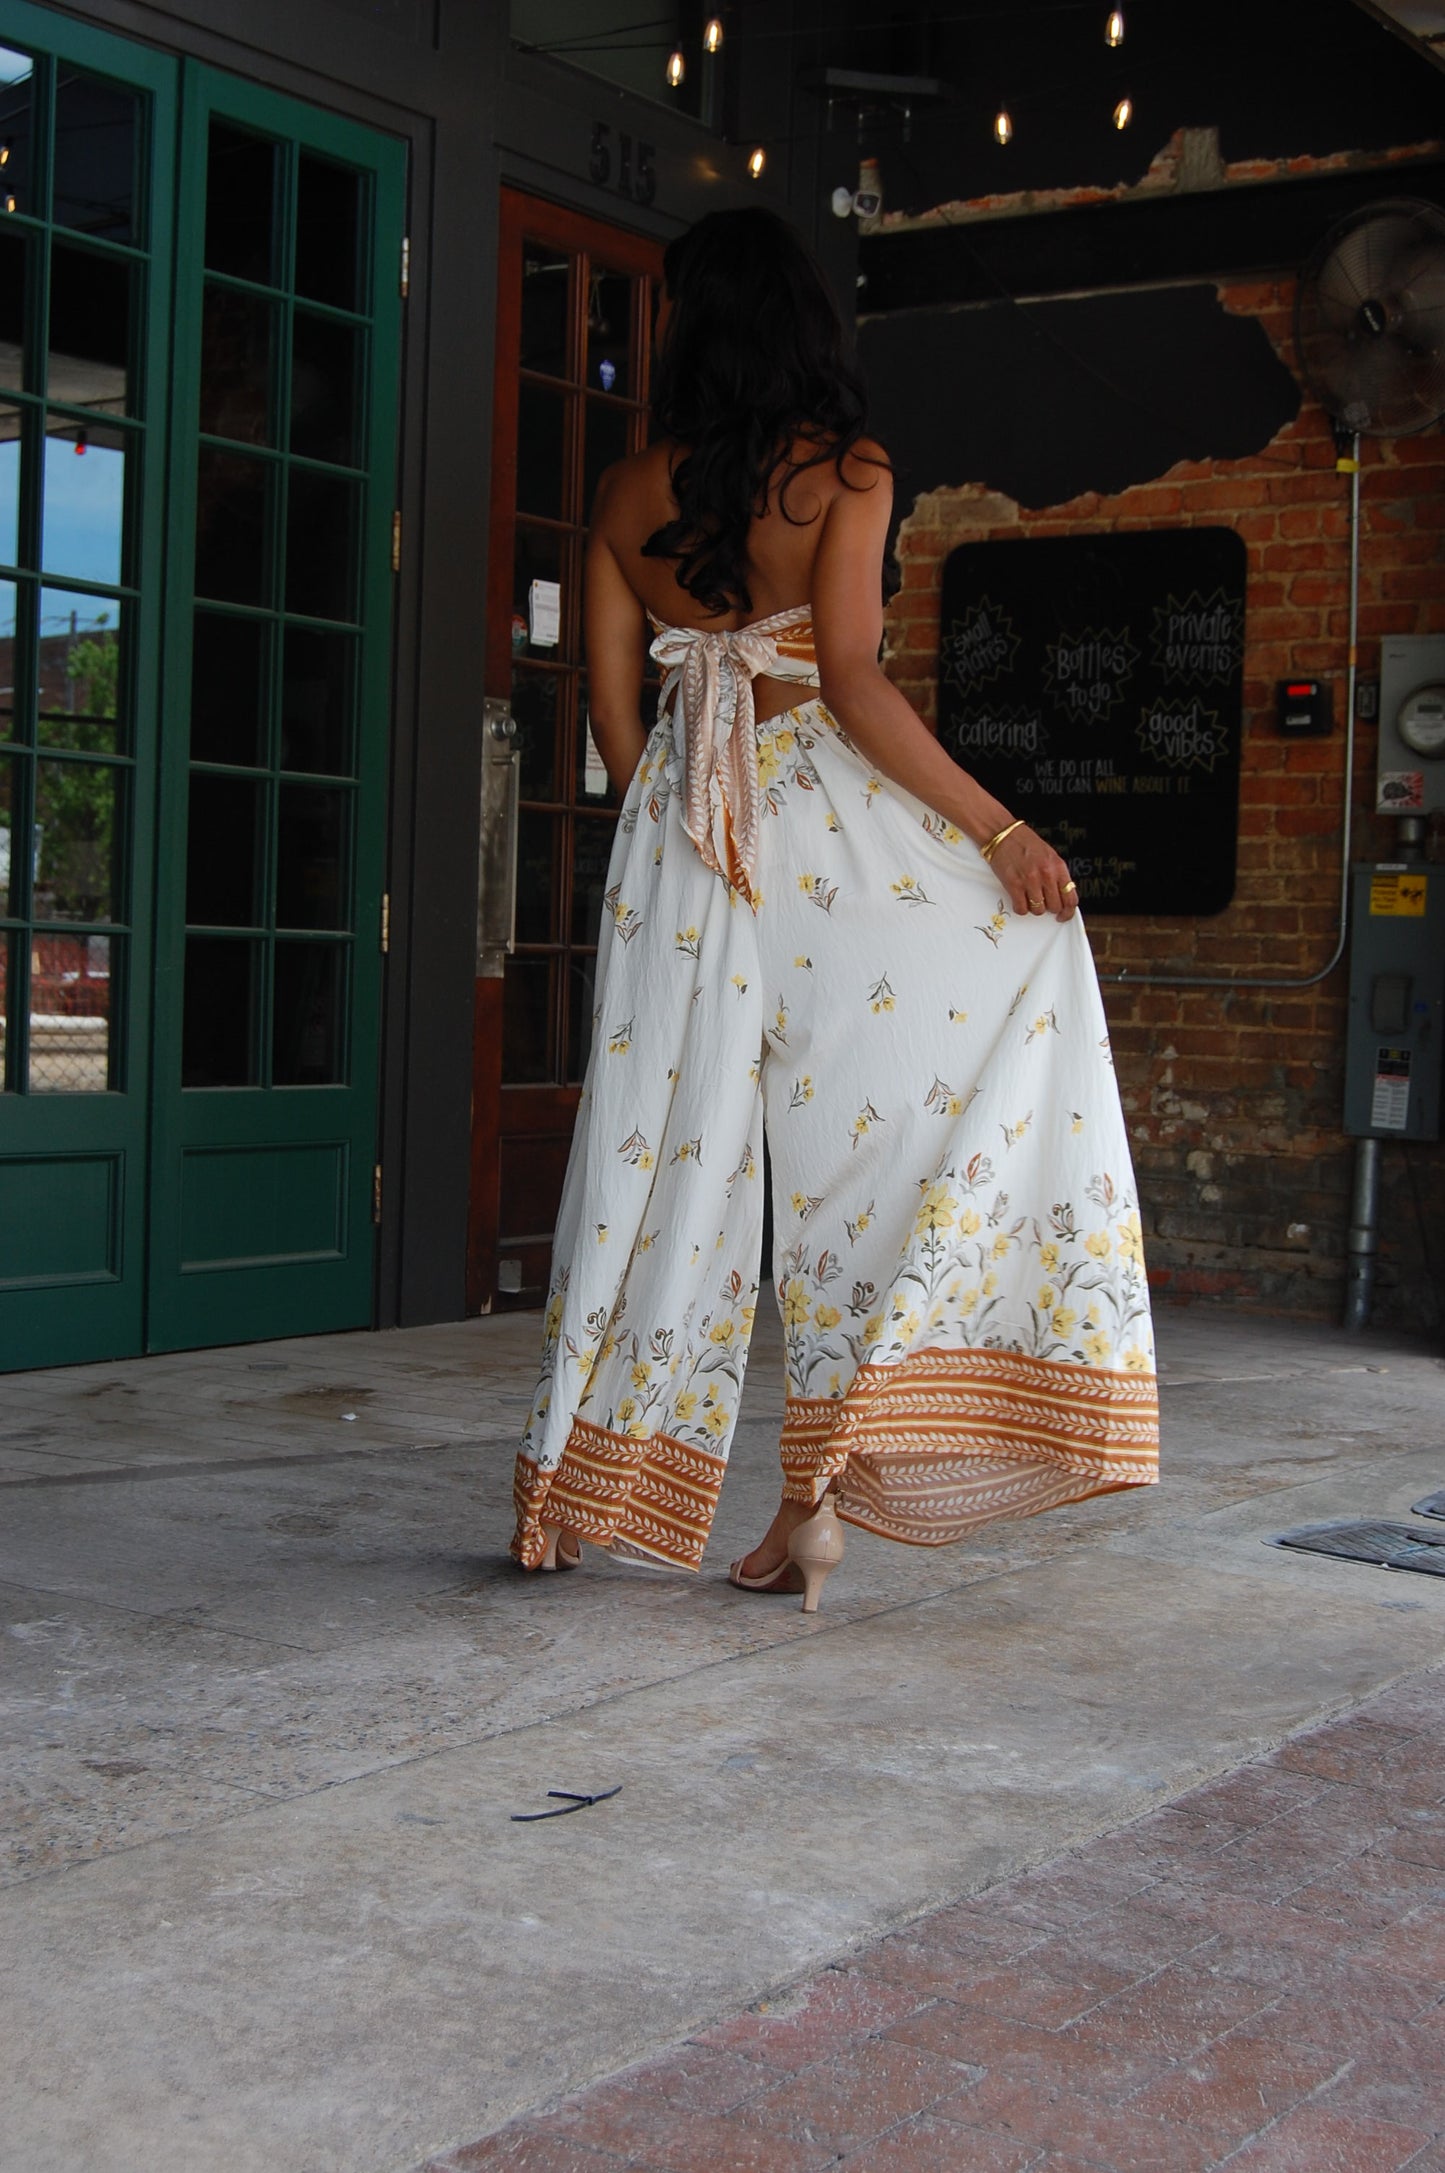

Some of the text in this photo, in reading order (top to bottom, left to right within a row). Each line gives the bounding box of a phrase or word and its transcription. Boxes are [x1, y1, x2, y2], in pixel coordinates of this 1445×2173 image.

[590, 121, 656, 205] 515
[1057, 642, 1127, 681] Bottles
[1165, 643, 1233, 673] events
[1066, 681, 1111, 713] to go
[958, 715, 1038, 751] catering
[1148, 703, 1198, 745] good
[1163, 730, 1216, 758] vibes
[1034, 759, 1117, 777] WE DO IT ALL
[1016, 777, 1034, 795] SO
[1037, 777, 1063, 795] YOU
[1066, 777, 1092, 794] CAN
